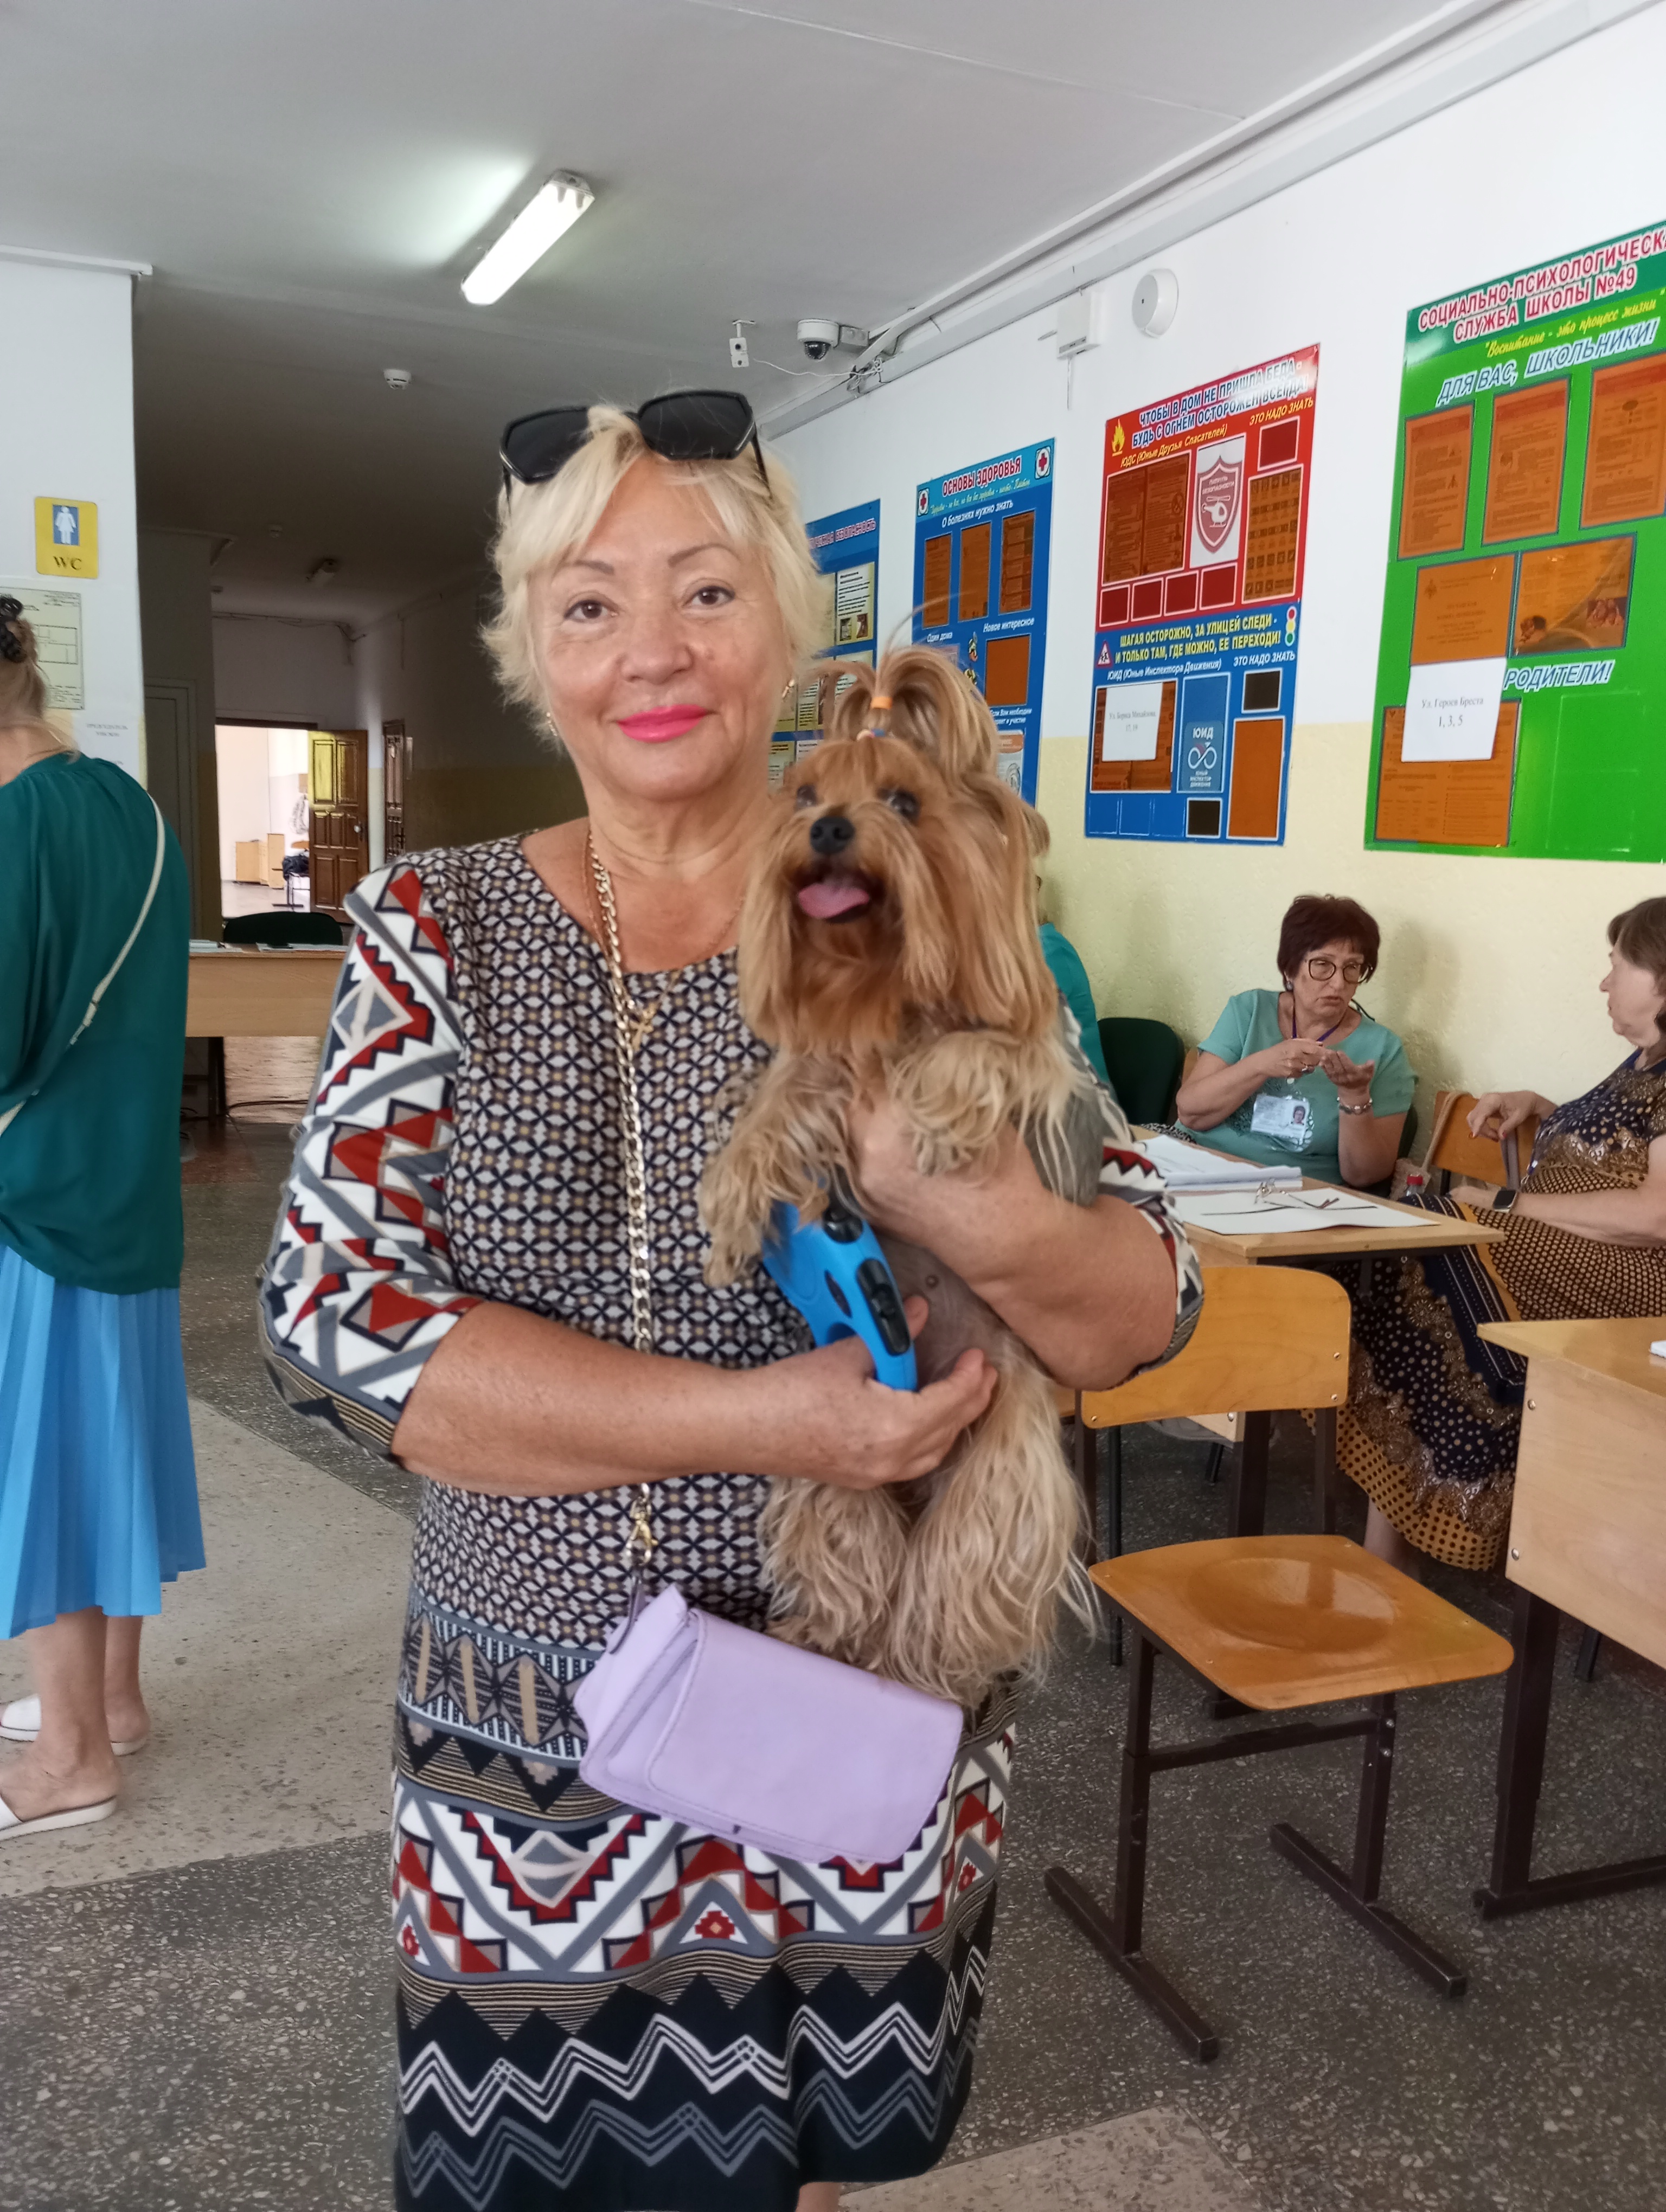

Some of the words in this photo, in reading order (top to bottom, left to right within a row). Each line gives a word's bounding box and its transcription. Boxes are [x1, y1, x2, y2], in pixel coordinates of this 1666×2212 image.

[1419, 228, 1666, 330] СОЦИАЛЬНО-ПСИХОЛОГИЧЕСК
[1454, 305, 1517, 341] СЛУЖБА
[1526, 280, 1590, 319] ШКОЛЫ
[1595, 266, 1636, 297] №49
[1579, 309, 1619, 335] процесс
[1436, 371, 1476, 407] ДЛЯ
[1476, 360, 1518, 391] ВАС,
[1524, 318, 1660, 378] ШКОЛЬНИКИ!
[1140, 404, 1171, 427] ЧТОБЫ
[1172, 401, 1178, 416] В
[1181, 395, 1201, 415] ДОМ
[1203, 387, 1217, 404] НЕ
[1219, 370, 1263, 399] ПРИШЛА
[1266, 358, 1295, 382] БЕДА
[1133, 429, 1154, 448] БУДЬ
[1156, 424, 1163, 439] С
[1164, 413, 1195, 436] ОГНЕМ
[1197, 391, 1259, 425] ОСТОРОЖЕН
[1250, 412, 1265, 426] ЭТО
[1265, 405, 1287, 421] НАДО
[1288, 397, 1313, 414] ЗНАТЬ
[1120, 454, 1136, 467] ЮДС
[1158, 441, 1182, 458] Друзья
[1184, 423, 1228, 447] Спасателей)
[943, 471, 976, 497] ОСНОВЫ
[977, 456, 1021, 488] ЗДОРОВЬЯ
[942, 517, 946, 528] О
[947, 512, 974, 526] болезнях
[975, 505, 994, 519] нужно
[995, 500, 1013, 512] знать
[53, 556, 81, 570] WC
[983, 622, 1001, 633] Новое
[1001, 618, 1035, 630] интересное
[1120, 633, 1144, 647] ШАГАЯ
[1145, 626, 1193, 644] ОСТОРОЖНО,
[1195, 623, 1204, 637] ЗА
[1207, 615, 1240, 635] УЛИЦЕЙ
[1242, 614, 1272, 631] СЛЕДИ
[1115, 652, 1120, 664] И
[1123, 648, 1149, 663] ТОЛЬКО
[1150, 646, 1167, 660] ТАМ,
[1169, 643, 1183, 659] ГДЕ
[1184, 640, 1216, 655] МОЖНО,
[1232, 631, 1281, 649] ПЕРЕХОДИ!
[1233, 655, 1247, 667] ЭТО
[1249, 653, 1271, 666] НАДО
[1271, 651, 1296, 663] ЗНАТЬ
[1144, 664, 1184, 676] Инспектора
[1183, 658, 1221, 674] Движения)
[1503, 660, 1614, 692] РОДИТЕЛИ!
[1434, 698, 1458, 709] Героев
[1460, 696, 1484, 708] Бреста
[1193, 727, 1214, 740] ЮИД
[1439, 716, 1445, 728] 1,
[1458, 715, 1463, 726] 5
